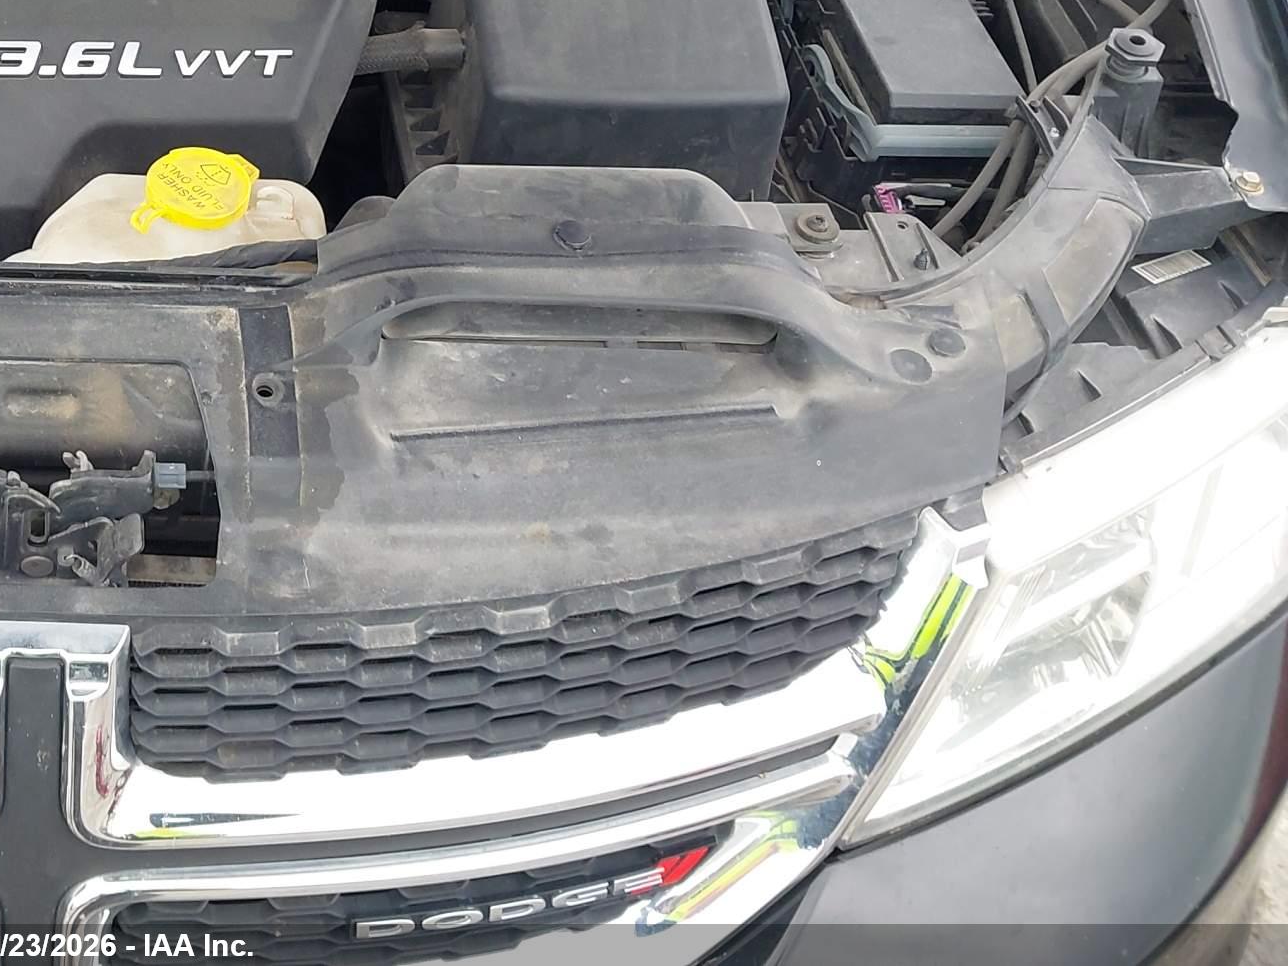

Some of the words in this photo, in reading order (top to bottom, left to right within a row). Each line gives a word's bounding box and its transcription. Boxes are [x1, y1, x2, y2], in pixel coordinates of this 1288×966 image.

[174, 49, 293, 79] VVT
[162, 162, 192, 184] ONLY
[158, 173, 206, 209] WASHER
[191, 185, 224, 210] FLUID
[352, 866, 666, 939] DODGE
